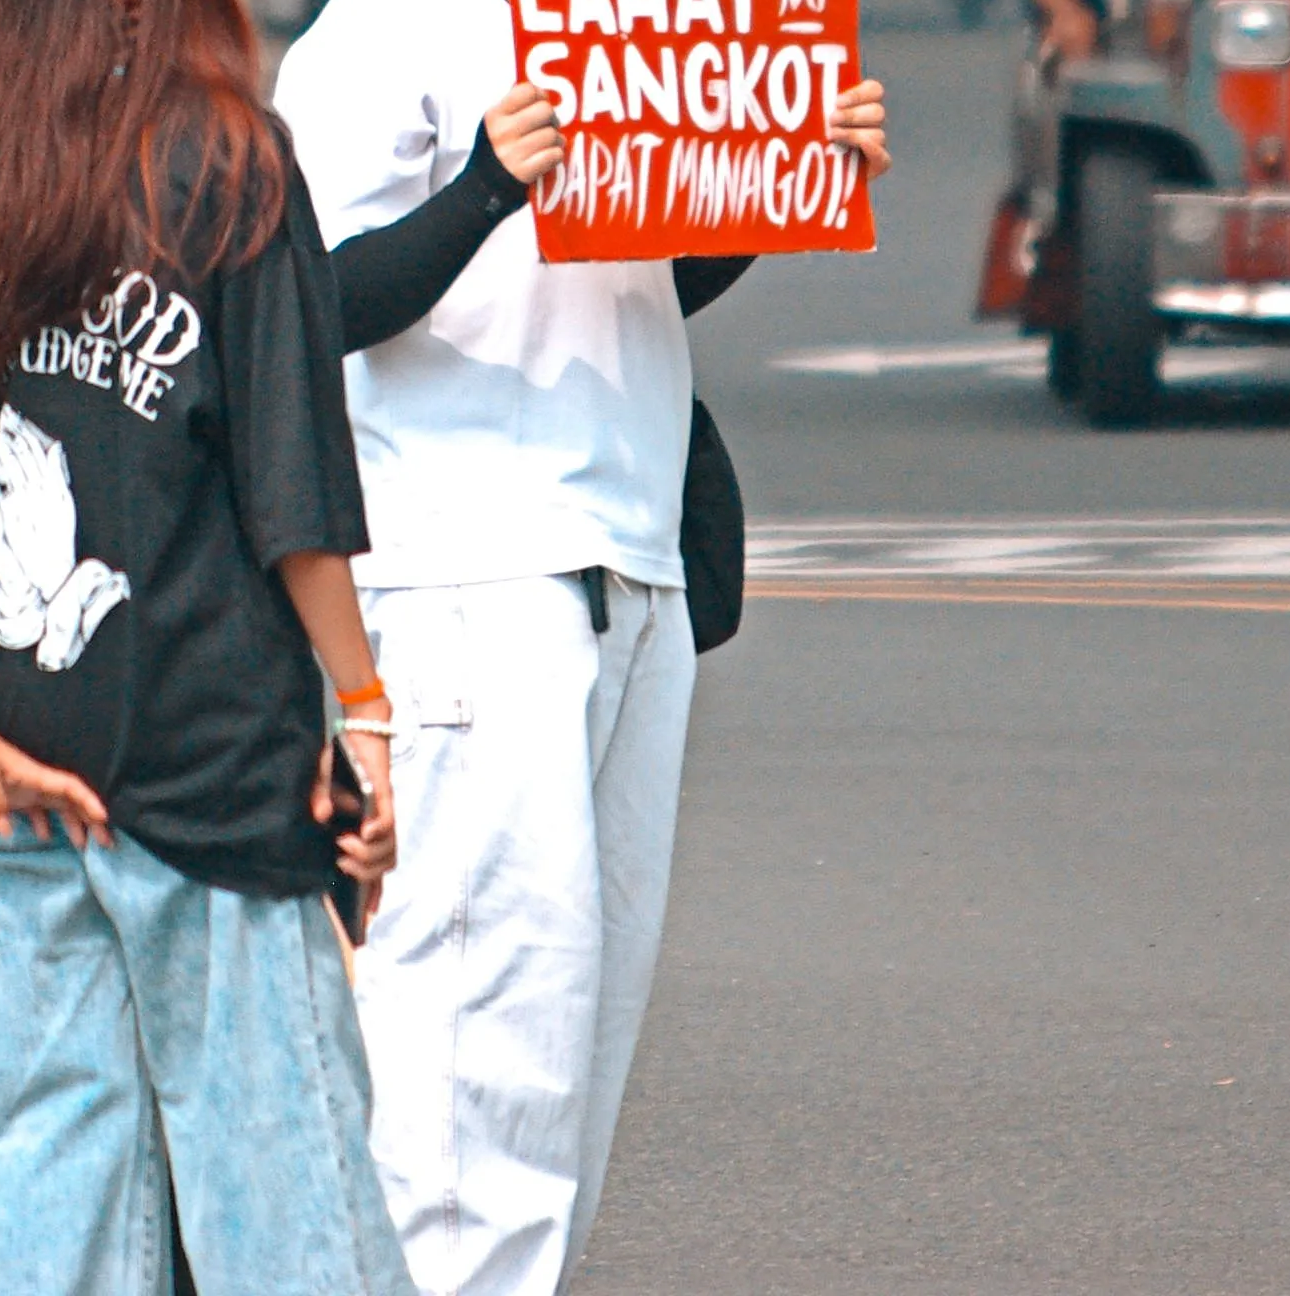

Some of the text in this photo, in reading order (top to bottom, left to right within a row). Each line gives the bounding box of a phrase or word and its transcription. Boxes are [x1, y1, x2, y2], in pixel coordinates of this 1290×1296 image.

[525, 41, 848, 140] SANGKOT
[536, 131, 859, 231] DAPAT MANAGOT!
[8, 326, 118, 390] UDGE
[119, 350, 176, 422] ME
